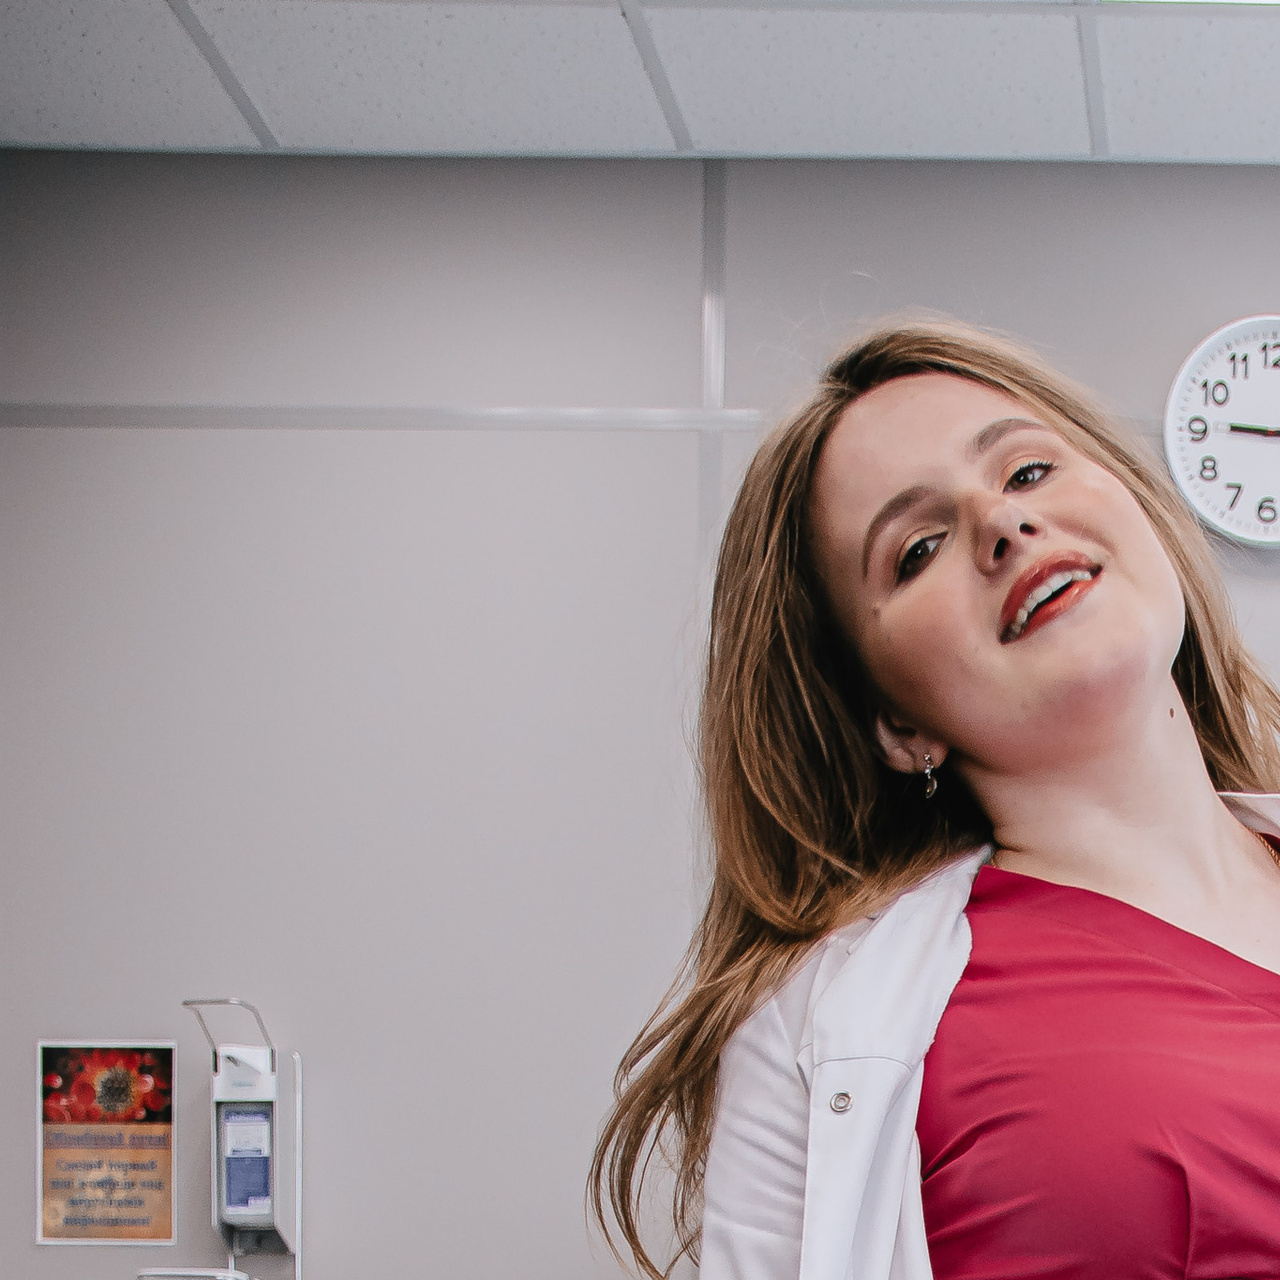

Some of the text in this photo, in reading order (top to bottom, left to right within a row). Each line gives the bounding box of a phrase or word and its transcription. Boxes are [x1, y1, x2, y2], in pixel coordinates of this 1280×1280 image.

[1228, 352, 1249, 378] 11
[1200, 378, 1229, 406] 10
[1188, 415, 1208, 442] 9
[1200, 455, 1217, 481] 8
[1226, 482, 1242, 509] 7
[1257, 496, 1277, 523] 6
